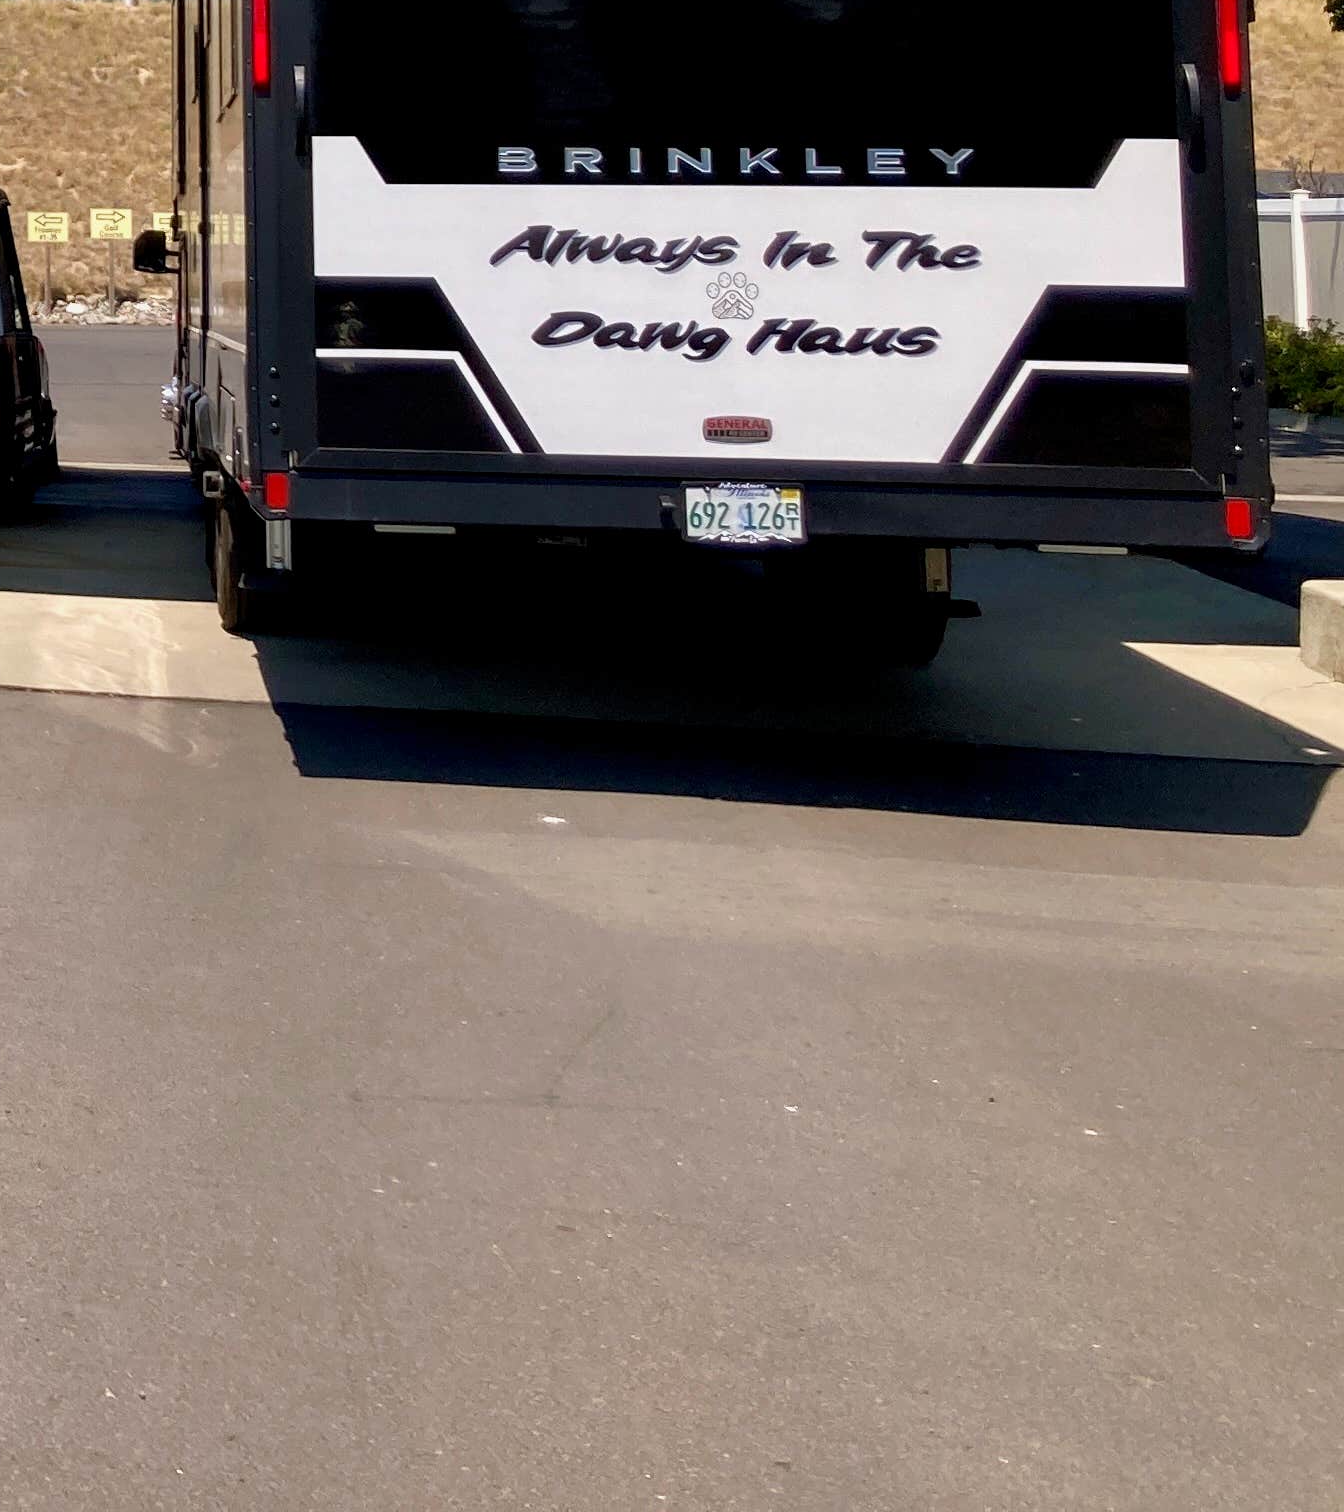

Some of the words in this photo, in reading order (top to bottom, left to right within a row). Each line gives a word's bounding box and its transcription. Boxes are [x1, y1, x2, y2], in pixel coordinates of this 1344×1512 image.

[497, 147, 974, 174] BRINKLEY
[489, 225, 740, 274] Always
[763, 230, 839, 271] In
[862, 230, 983, 272] The
[530, 311, 733, 363] Dawg
[746, 318, 941, 357] Haus
[706, 418, 768, 429] GENERAL
[690, 501, 730, 529] 692
[743, 502, 785, 530] 126
